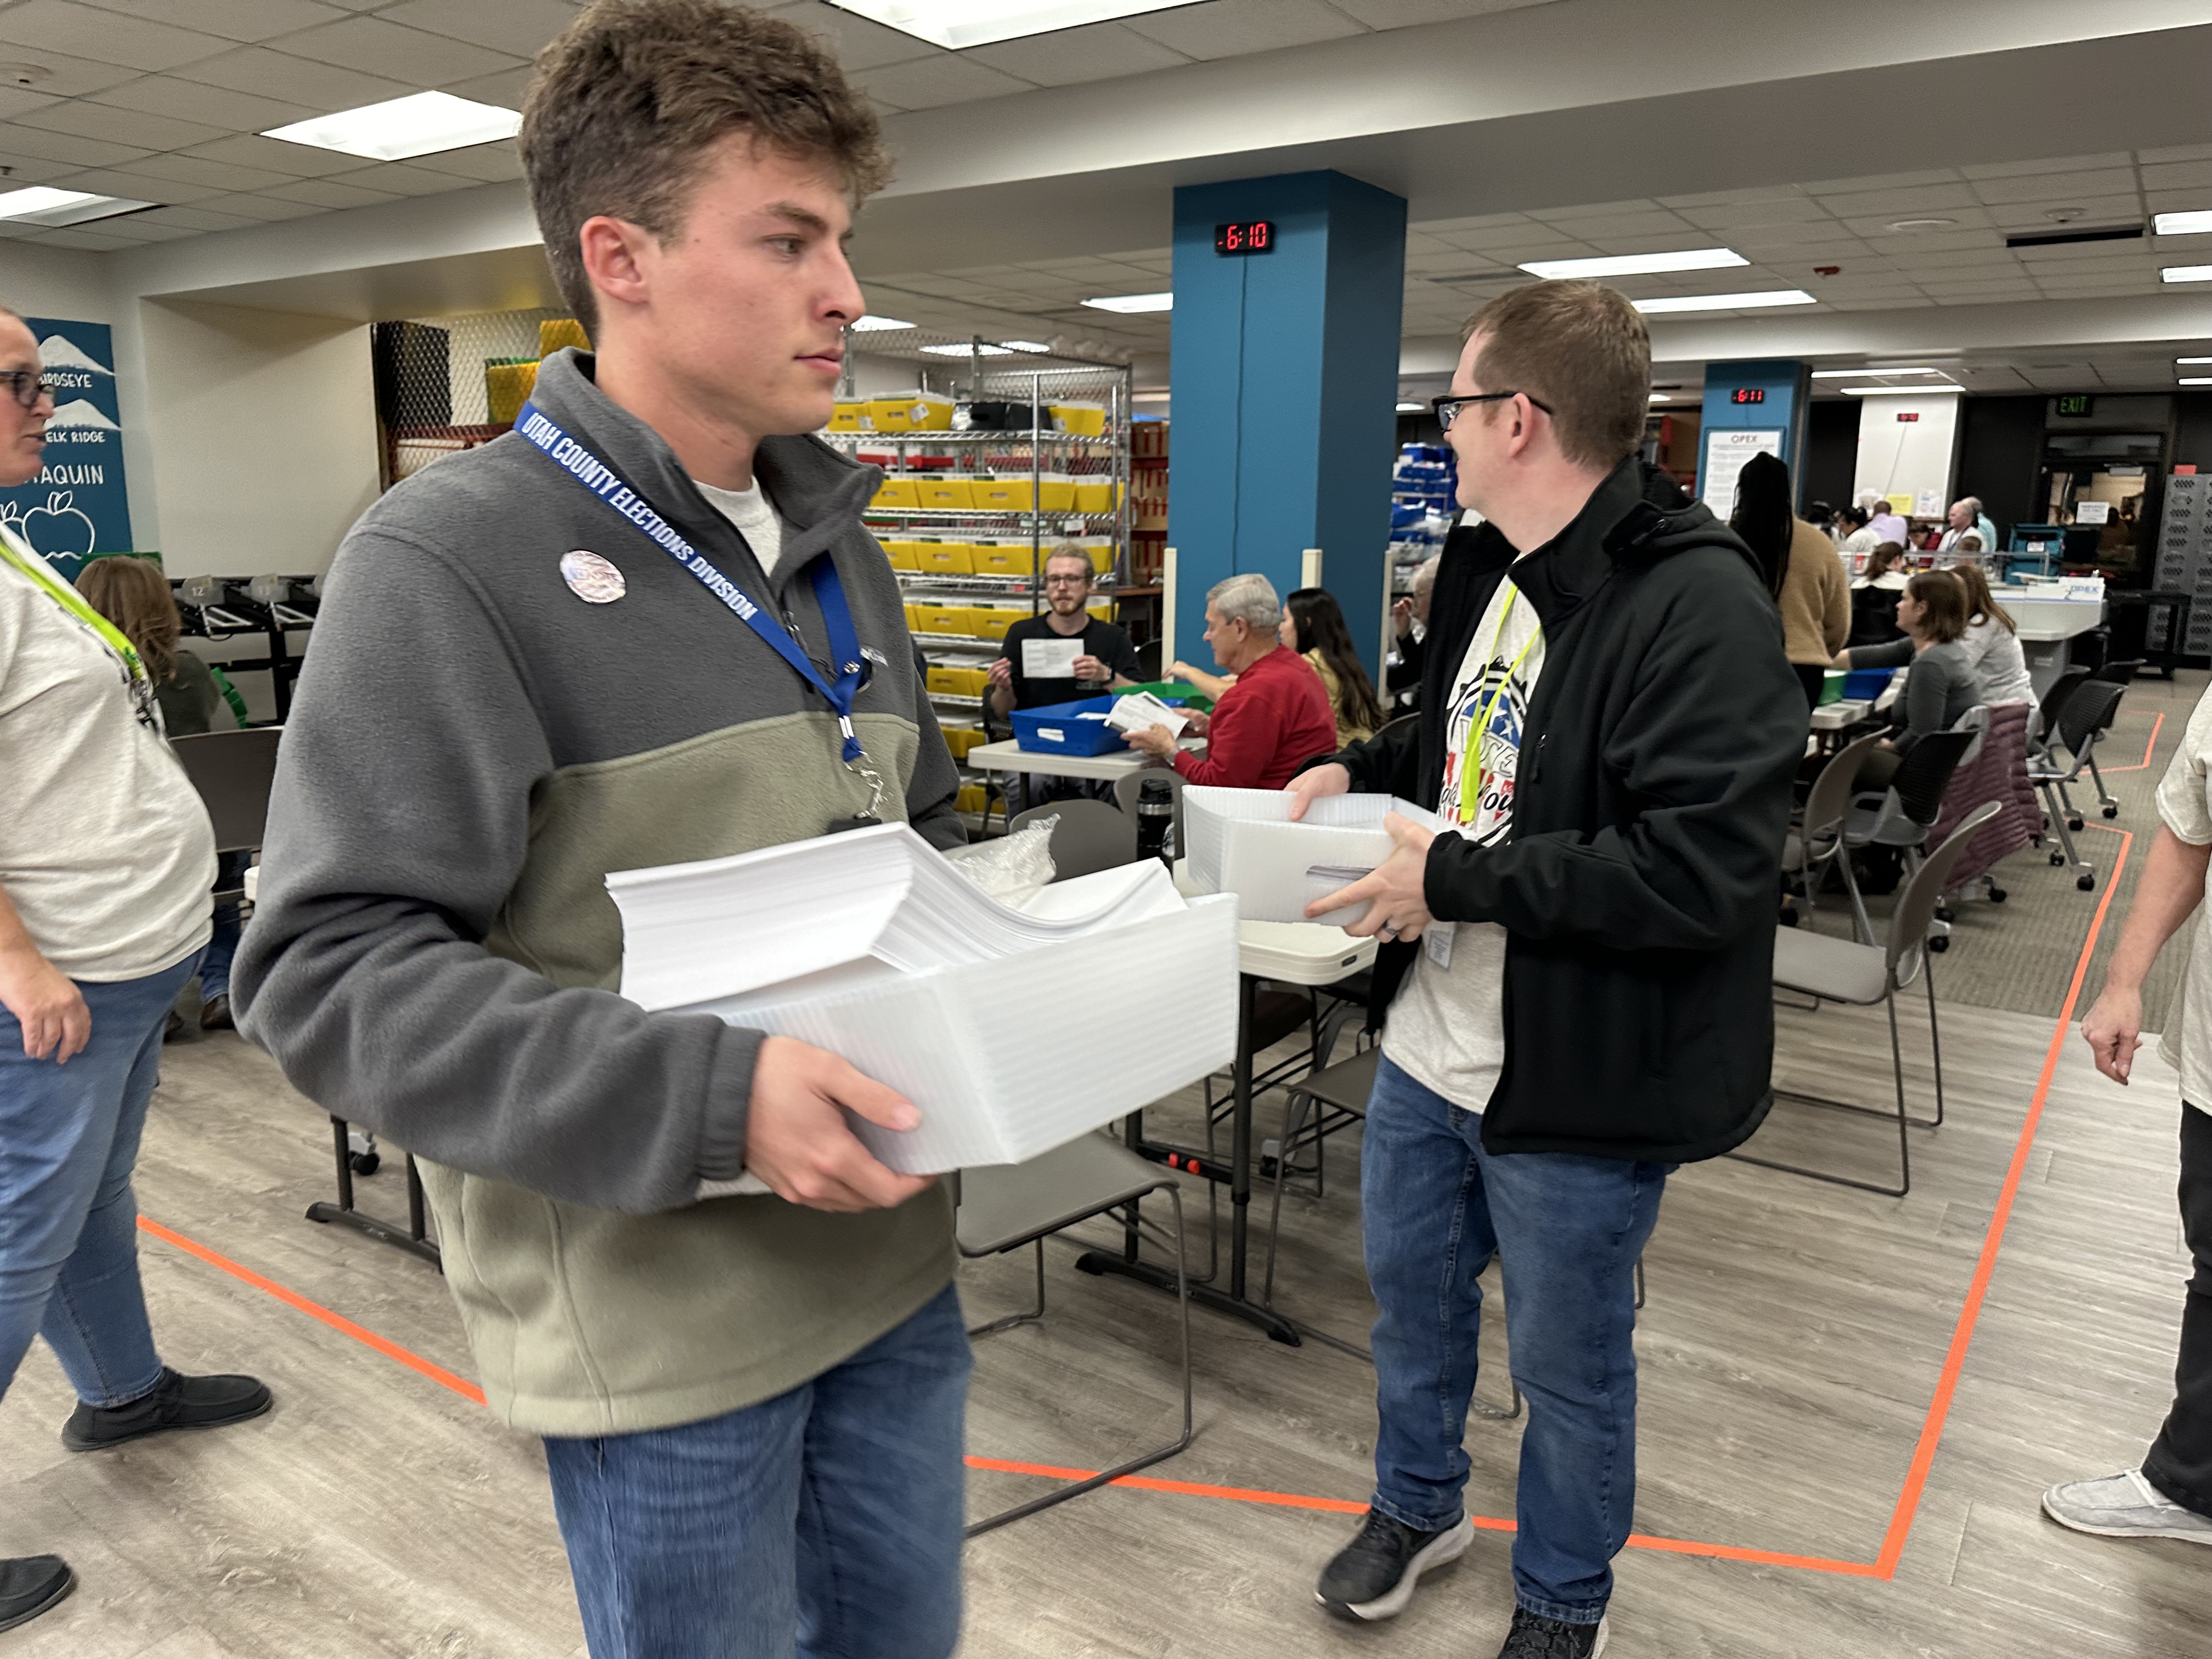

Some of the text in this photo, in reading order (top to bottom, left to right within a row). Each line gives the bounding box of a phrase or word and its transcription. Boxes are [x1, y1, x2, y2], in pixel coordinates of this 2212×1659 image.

[2061, 396, 2087, 413] EXIT
[46, 431, 105, 443] ELK RIDGE
[521, 412, 562, 450] UTAH
[551, 437, 622, 495] COUNTY
[608, 487, 695, 561] ELECTIONS
[687, 556, 758, 621] DIVISION
[191, 586, 205, 596] 12
